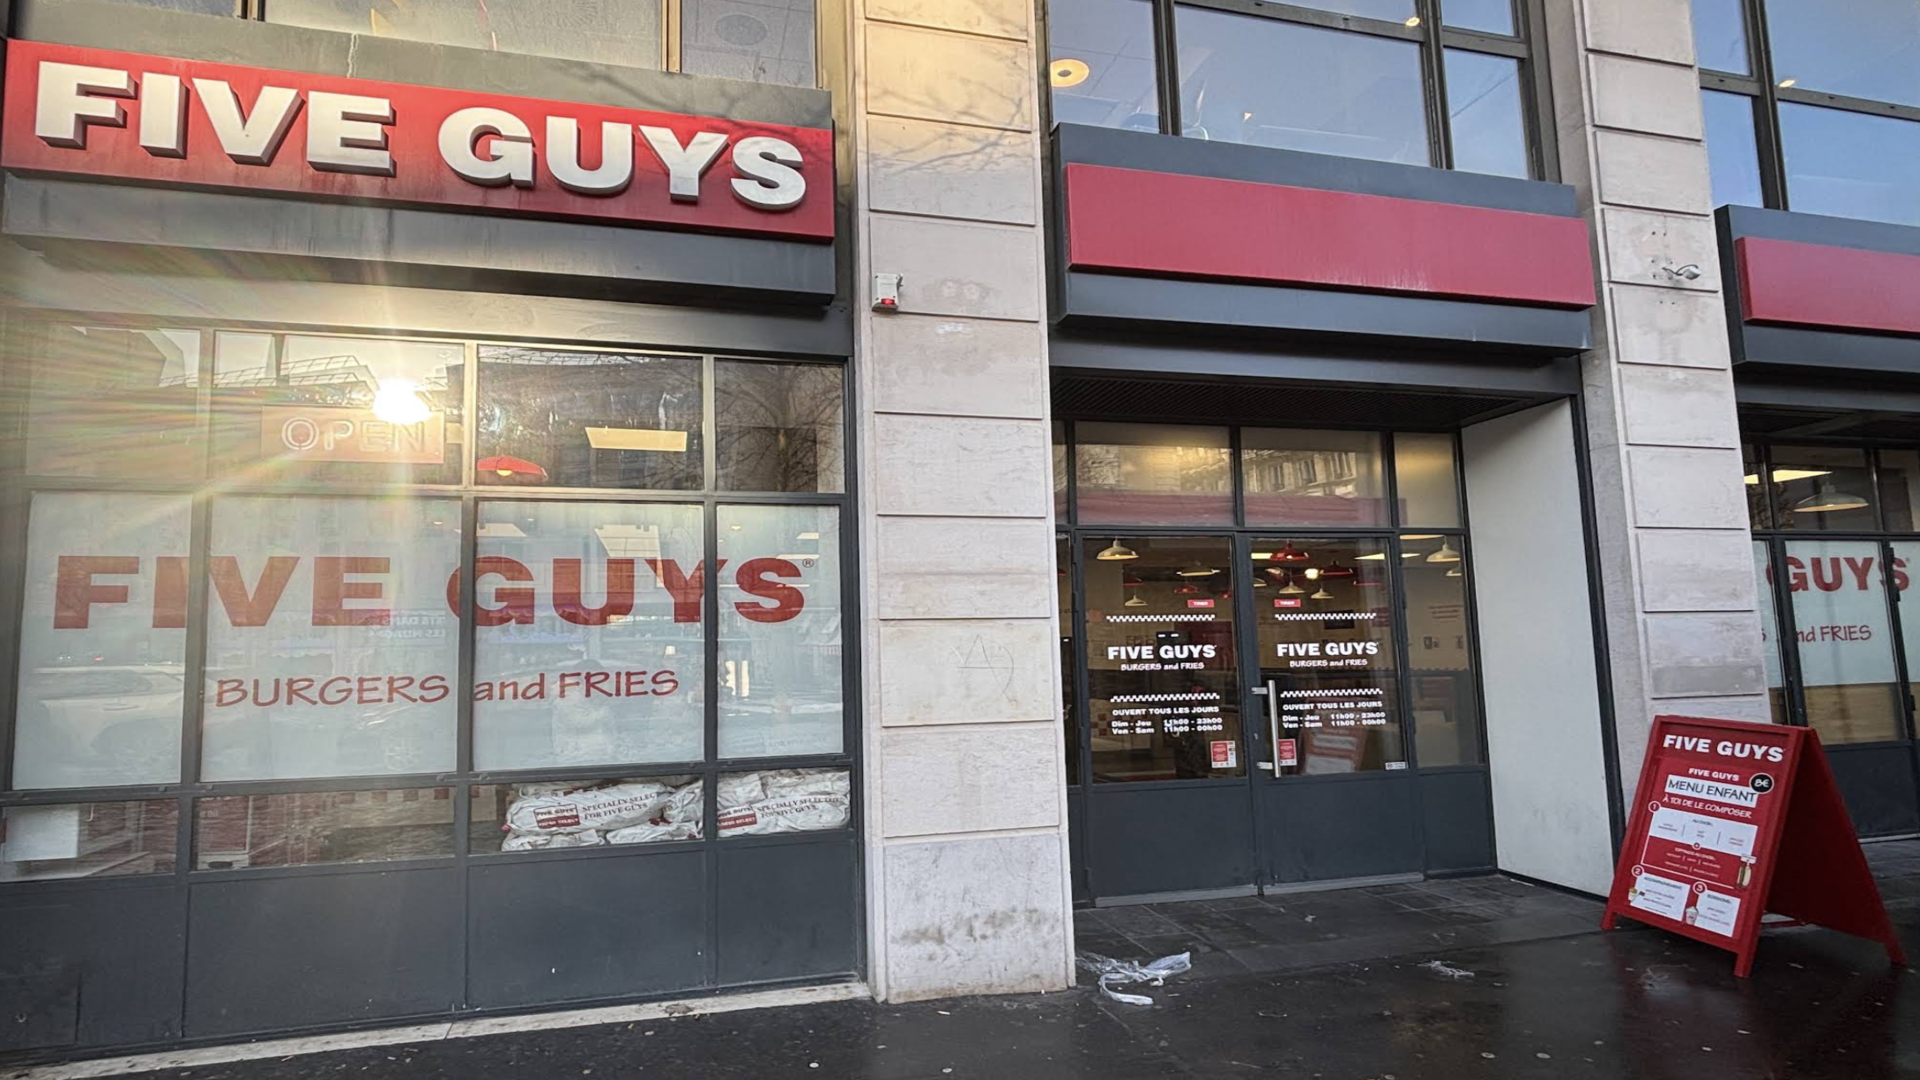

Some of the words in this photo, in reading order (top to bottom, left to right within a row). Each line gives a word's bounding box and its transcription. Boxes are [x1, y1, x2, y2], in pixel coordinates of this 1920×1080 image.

[35, 60, 396, 177] FIVE
[438, 106, 807, 211] GUYS
[281, 416, 426, 452] OPEN
[53, 555, 392, 629] FIVE
[1820, 625, 1872, 642] FRIES
[1107, 645, 1154, 660] FIVE
[1159, 644, 1216, 659] GUYS
[1277, 643, 1320, 657] FIVE
[1325, 641, 1378, 656] GUYS
[1120, 663, 1161, 671] BURGERS
[1180, 662, 1204, 670] FRIES
[1289, 660, 1328, 668] BURGERS
[1329, 659, 1344, 667] and
[1345, 658, 1368, 666] FRIES
[215, 674, 449, 708] BURGERS
[474, 672, 546, 702] and
[559, 669, 679, 700] FRIES
[1112, 708, 1147, 716] OUVERT
[1148, 707, 1172, 715] TOUS
[1173, 706, 1190, 714] LES
[1282, 703, 1315, 711] OUVERT
[1339, 701, 1355, 709] LES
[1163, 718, 1189, 726] 11h00
[1196, 717, 1223, 725] 23h00
[1163, 725, 1190, 733] 11h00
[1663, 734, 1712, 753] FIVE
[1716, 741, 1784, 763] GUYS
[1688, 767, 1711, 777] FIVE
[1711, 771, 1740, 782] GUYS
[1668, 779, 1704, 794] MENU
[1706, 785, 1757, 803] ENFANT
[582, 798, 628, 812] SPECIALLY
[584, 810, 602, 819] FOR
[603, 808, 623, 817] FIVE
[624, 803, 648, 812] GUYS
[757, 800, 798, 812] SPECIALLY
[795, 804, 818, 813] GUYS
[1662, 793, 1669, 802] À
[1670, 797, 1681, 805] TOI
[1682, 799, 1693, 808] DE
[1694, 801, 1703, 809] LE
[1704, 803, 1753, 819] COMPOSER
